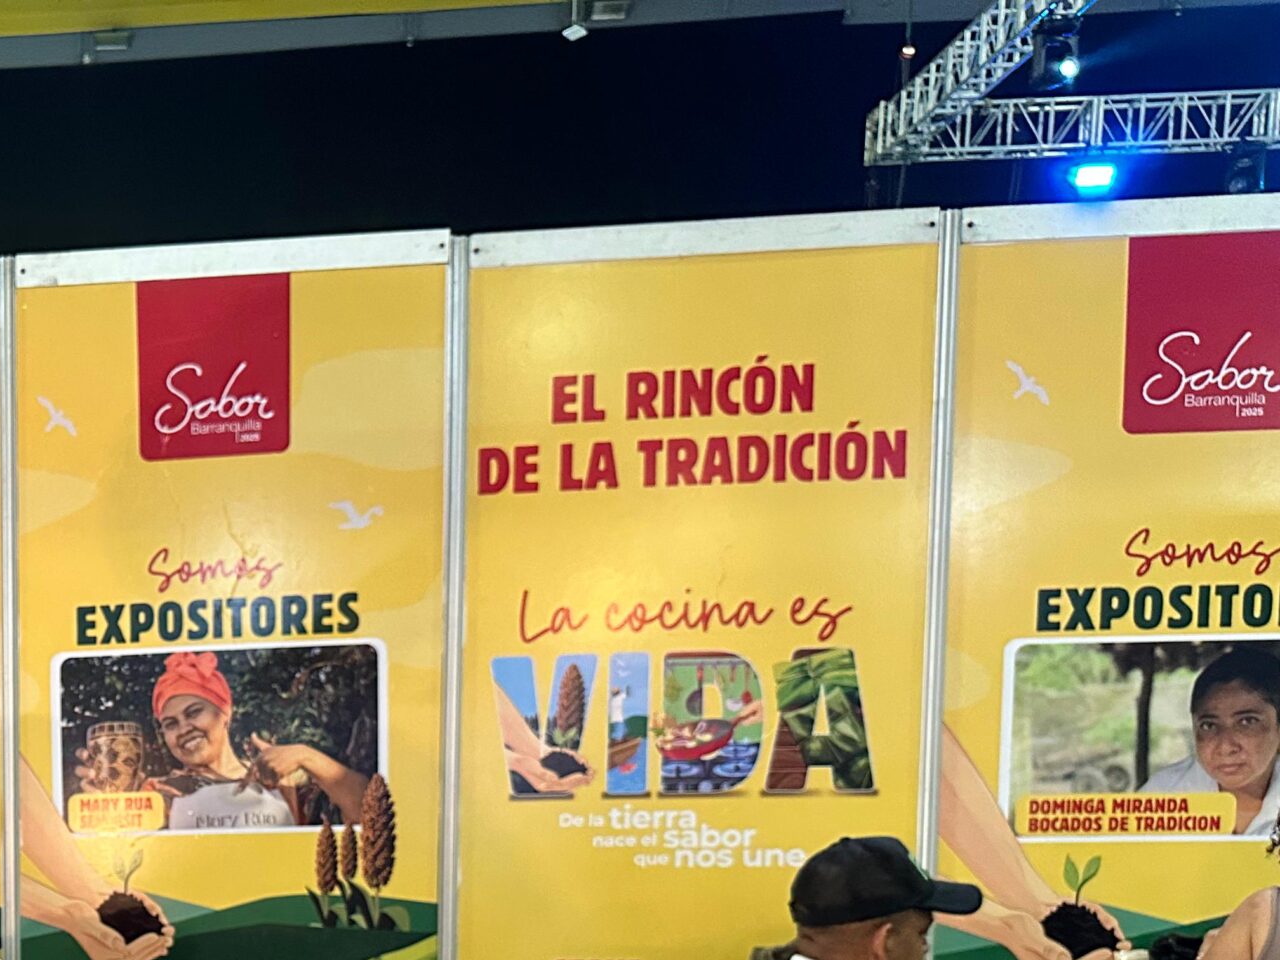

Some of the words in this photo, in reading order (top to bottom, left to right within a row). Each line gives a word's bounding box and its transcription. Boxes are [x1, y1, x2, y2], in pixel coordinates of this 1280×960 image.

[551, 374, 606, 424] EL
[625, 355, 815, 420] RINCÓN
[1142, 331, 1280, 405] Sabor
[155, 361, 274, 434] Sabor
[1184, 393, 1266, 417] Barranquilla
[1241, 407, 1264, 417] 2025
[191, 420, 261, 443] Barranquilla
[477, 446, 539, 495] DE
[559, 442, 619, 491] LA
[637, 421, 907, 488] TRADICIÓN
[148, 548, 283, 593] Somos
[1125, 527, 1280, 577] Somos
[76, 592, 360, 645] EXPOSITORES
[519, 590, 587, 644] La
[605, 588, 774, 633] cocina
[790, 595, 853, 642] es
[1036, 583, 1280, 631] EXPOSITO
[490, 648, 876, 796] VIDA
[80, 798, 119, 812] MARY
[125, 797, 153, 810] RUA
[559, 813, 584, 828] De
[589, 813, 604, 828] la
[609, 804, 696, 829] tierra
[1028, 799, 1105, 814] DOMINGA
[1112, 798, 1189, 813] MIRANDA
[1028, 817, 1102, 832] BOCADOS
[1108, 817, 1129, 831] DE
[1136, 816, 1221, 831] TRADICION
[592, 835, 637, 847] nace
[641, 833, 657, 847] el
[663, 824, 756, 848] sabor
[633, 854, 669, 868] que
[674, 850, 733, 868] nos
[743, 849, 806, 868] une
